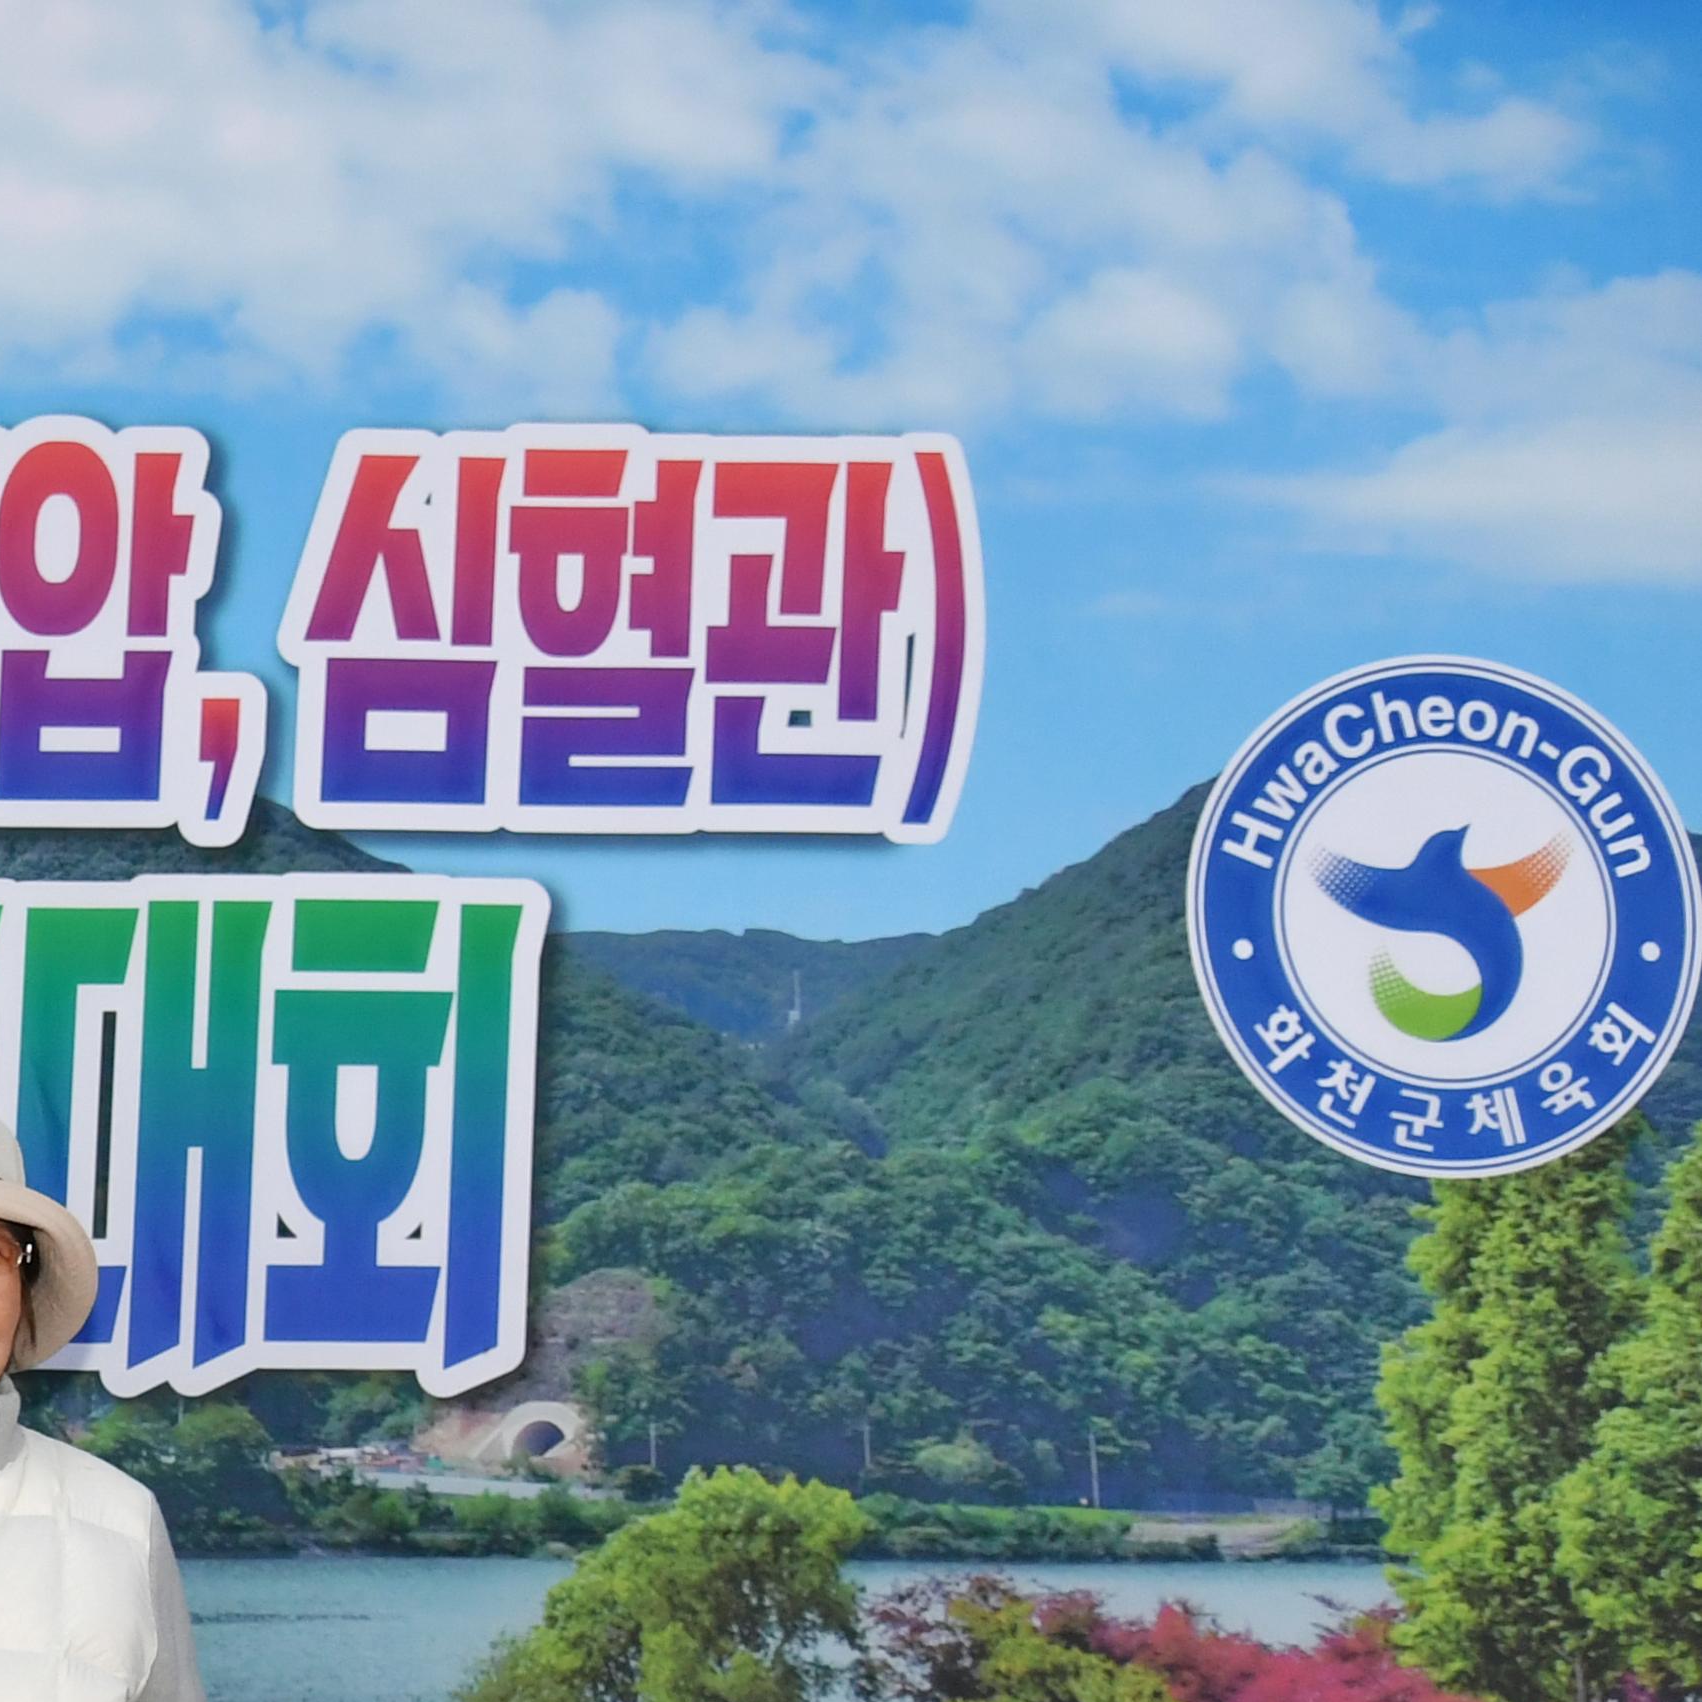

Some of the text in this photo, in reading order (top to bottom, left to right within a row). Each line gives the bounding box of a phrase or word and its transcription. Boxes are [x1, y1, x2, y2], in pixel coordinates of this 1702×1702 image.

[307, 446, 967, 825] 심혈관)
[1220, 691, 1652, 879] HwaCheon-Gun
[1254, 1001, 1657, 1153] 화천군체육회
